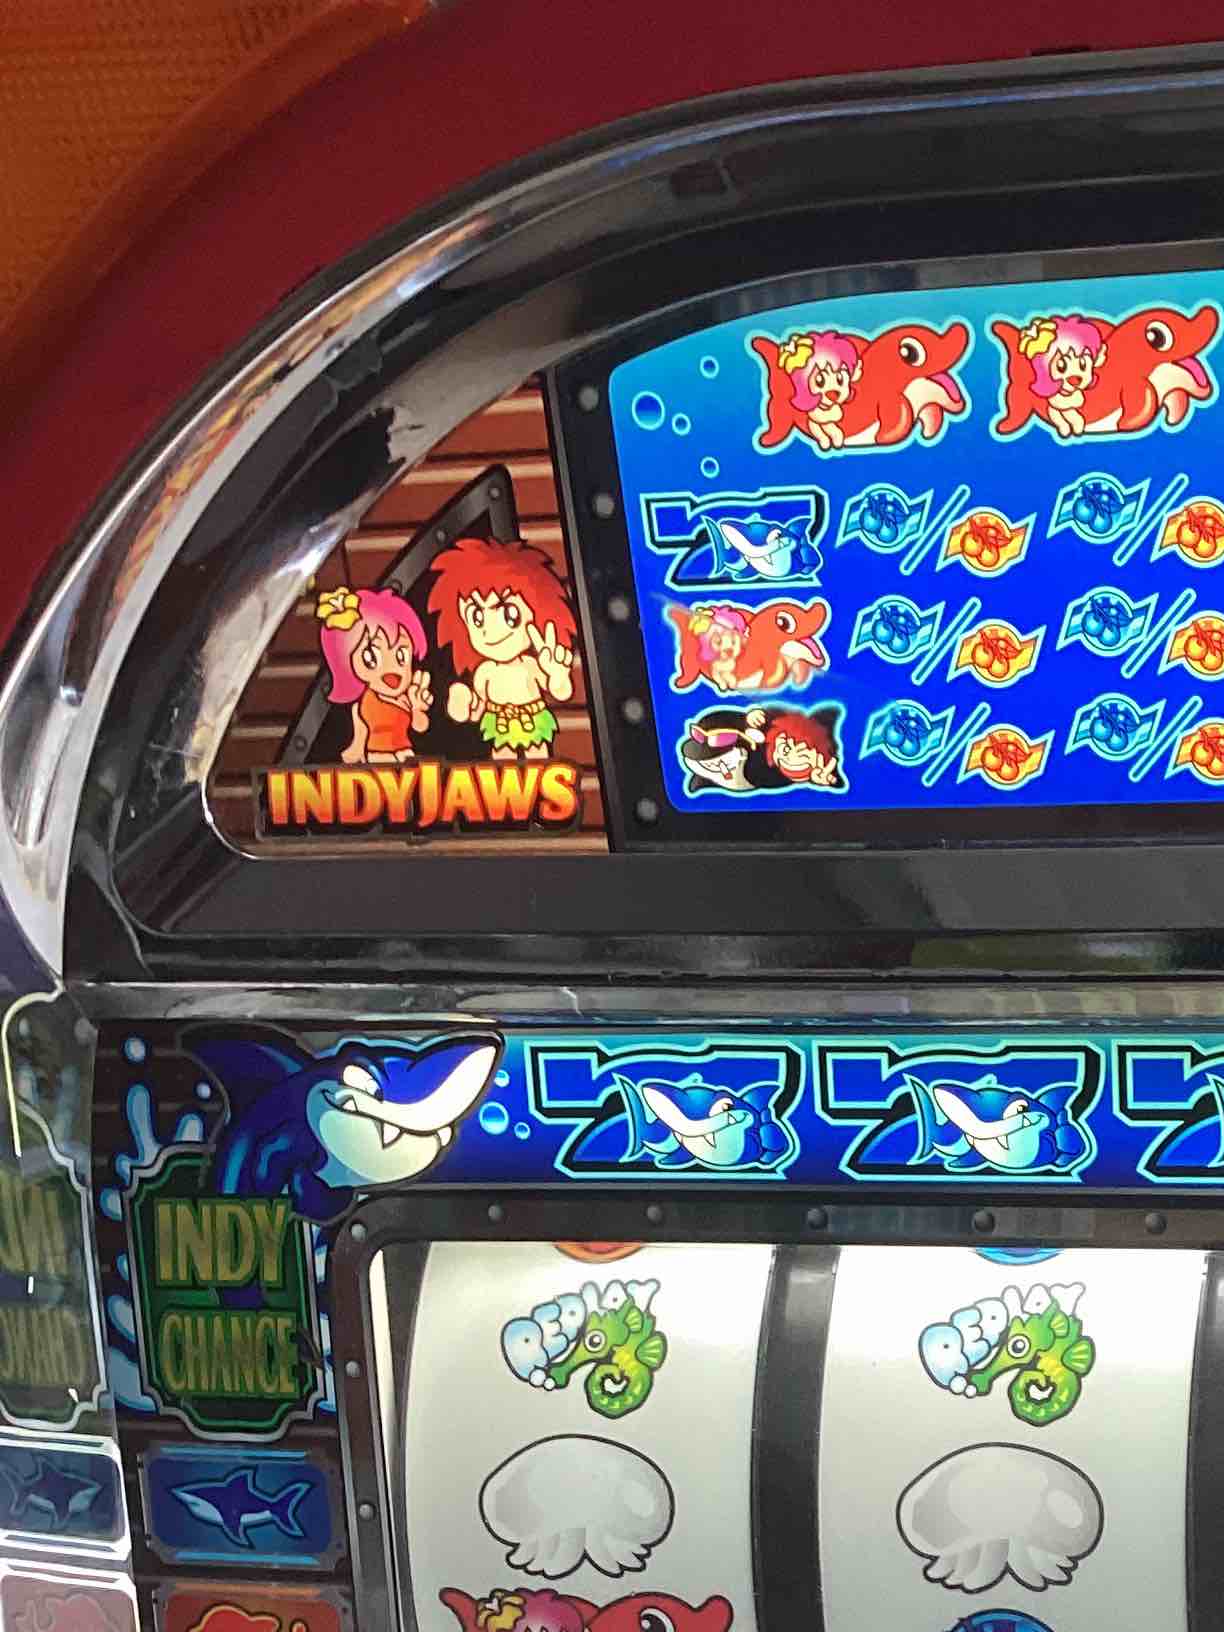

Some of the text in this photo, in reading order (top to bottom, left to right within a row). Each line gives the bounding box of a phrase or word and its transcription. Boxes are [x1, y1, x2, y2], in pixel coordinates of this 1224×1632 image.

[267, 762, 577, 828] INDYJAWS
[155, 1200, 289, 1288] INDY
[160, 1312, 297, 1395] CHANCE
